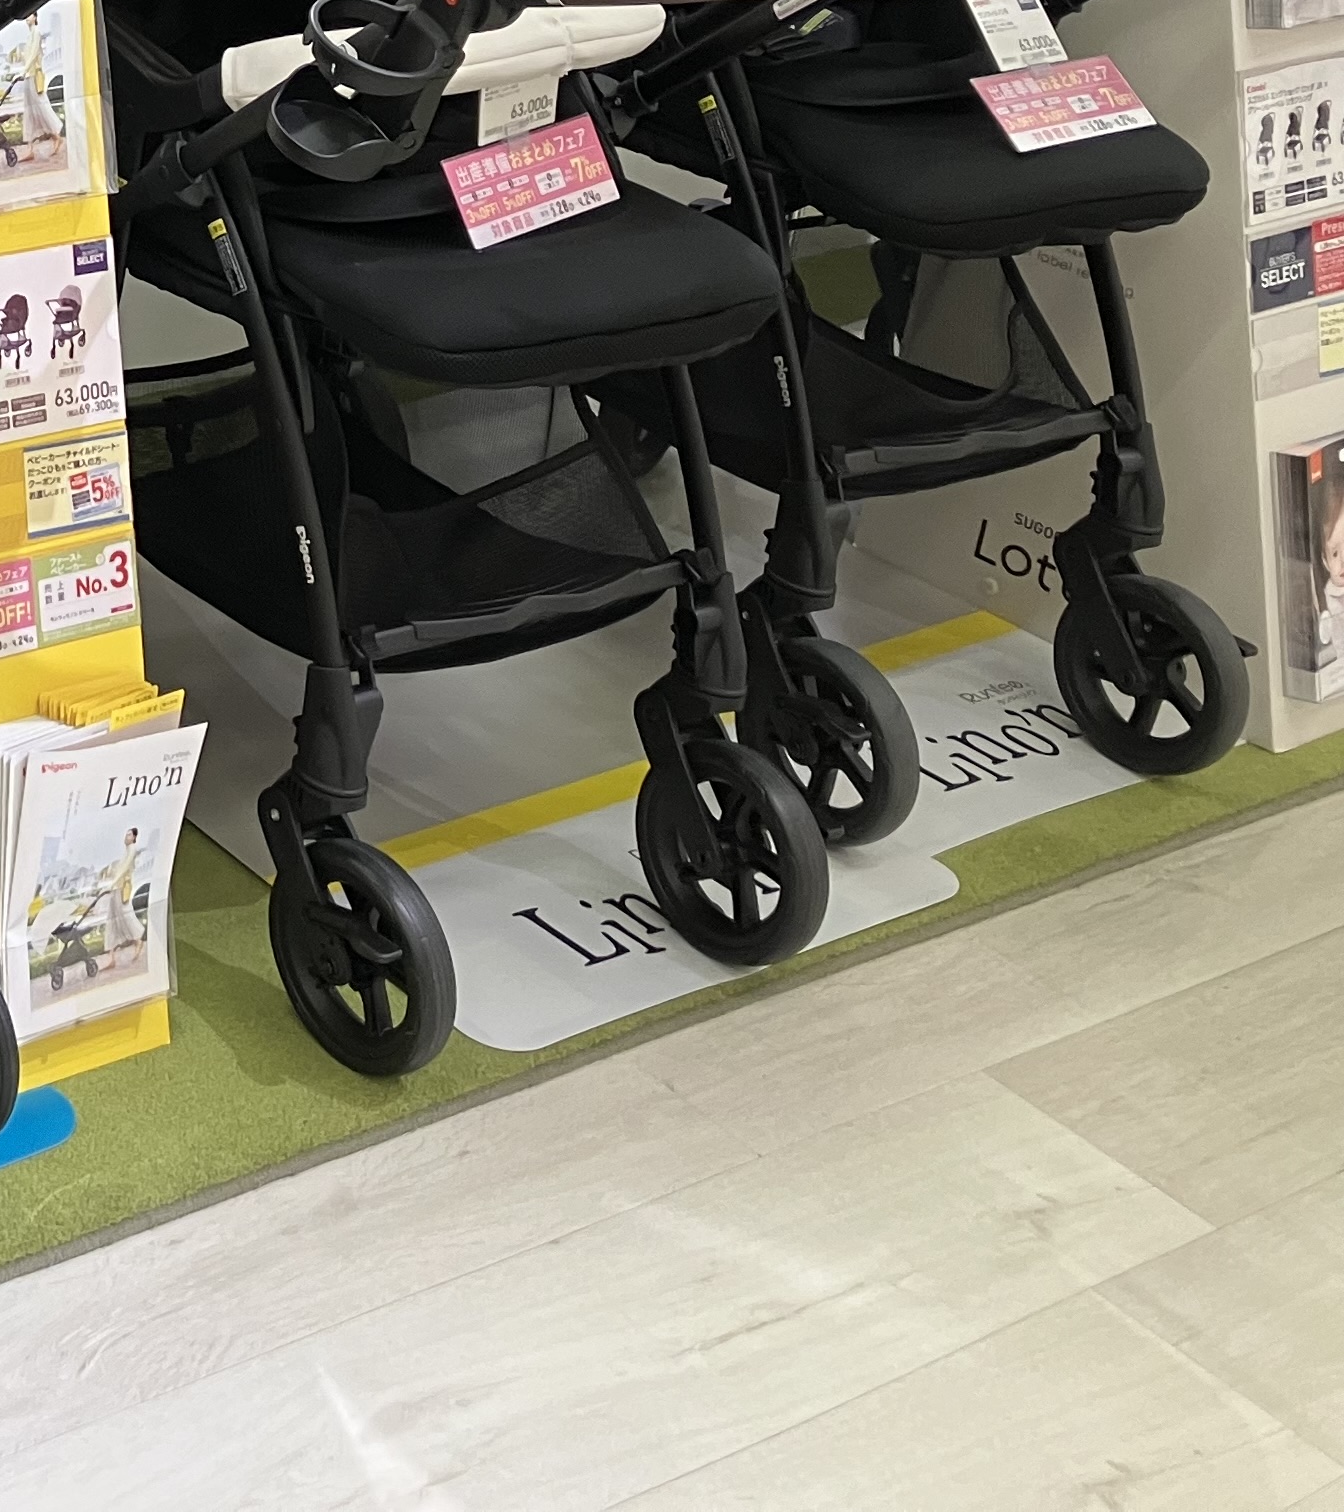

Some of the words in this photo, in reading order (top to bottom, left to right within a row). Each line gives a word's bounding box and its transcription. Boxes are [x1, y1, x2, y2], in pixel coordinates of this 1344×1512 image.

[1260, 260, 1306, 289] SELECT
[54, 380, 118, 406] 63,000円
[295, 525, 315, 585] pigeon
[103, 763, 184, 809] Lino'n
